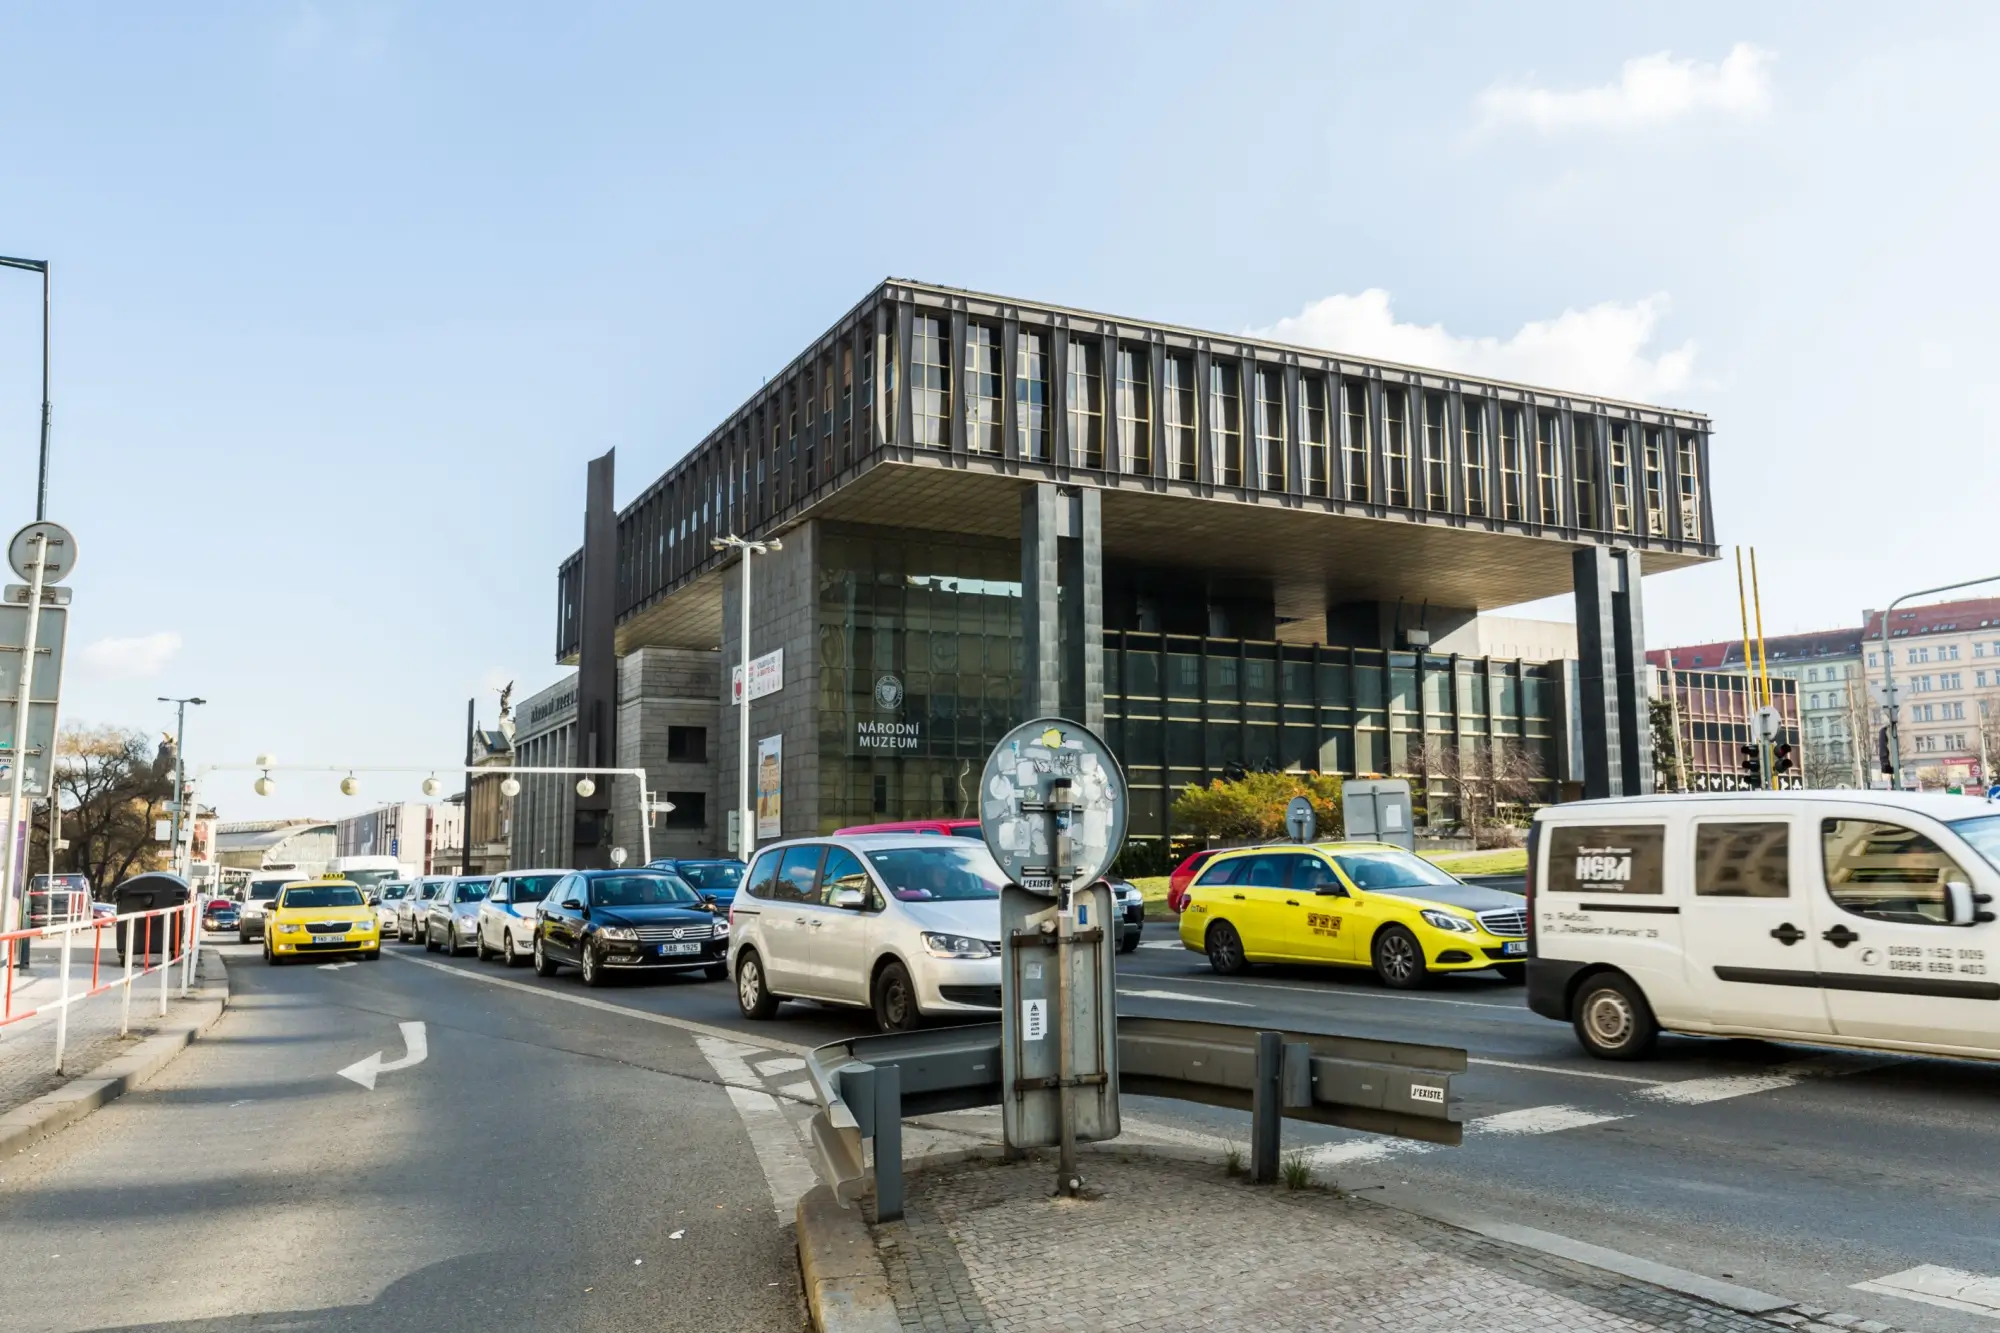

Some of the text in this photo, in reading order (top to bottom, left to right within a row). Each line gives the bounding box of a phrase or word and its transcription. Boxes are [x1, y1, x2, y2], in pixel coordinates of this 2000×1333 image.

[857, 720, 920, 735] NÁRODNÍ
[859, 736, 918, 748] MUZEUM
[1023, 879, 1053, 888] J'EXISTE.
[1413, 1088, 1443, 1100] J'EXISTE.
